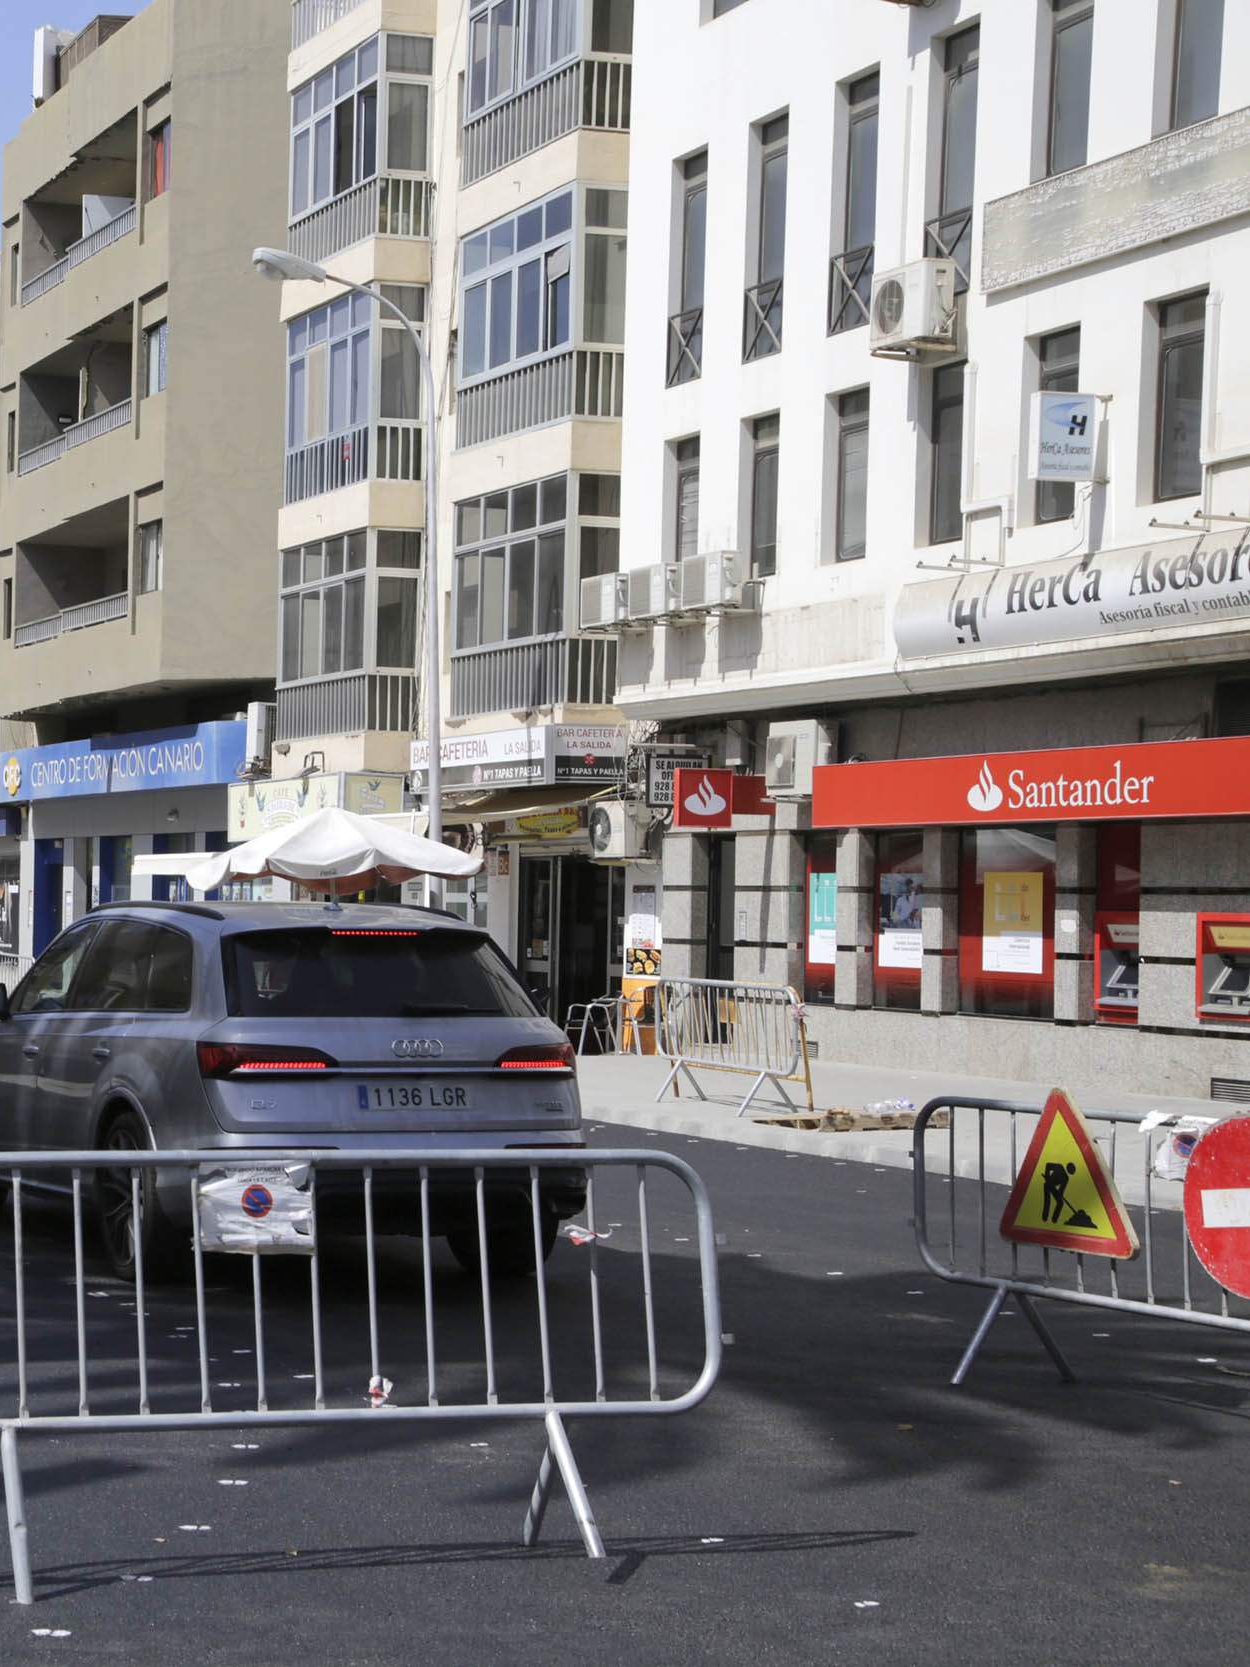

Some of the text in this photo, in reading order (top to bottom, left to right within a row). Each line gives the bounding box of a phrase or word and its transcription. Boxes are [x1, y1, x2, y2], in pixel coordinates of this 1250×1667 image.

[1005, 543, 1250, 614] HerCa Asesor
[1100, 590, 1250, 625] Asesoría fiscal y contab
[439, 739, 488, 761] AFETERIA
[566, 741, 612, 750] LA SALIDA
[31, 759, 67, 787] CENTRO
[68, 757, 81, 784] DE
[148, 741, 204, 776] CANARIO
[571, 767, 592, 775] TAPAS
[593, 767, 598, 775] Y
[655, 760, 665, 769] SE
[495, 768, 513, 780] TAPAS
[654, 781, 669, 790] 928
[1008, 760, 1154, 809] Santander
[654, 792, 669, 801] 928
[373, 1087, 467, 1107] 1136 LGR
